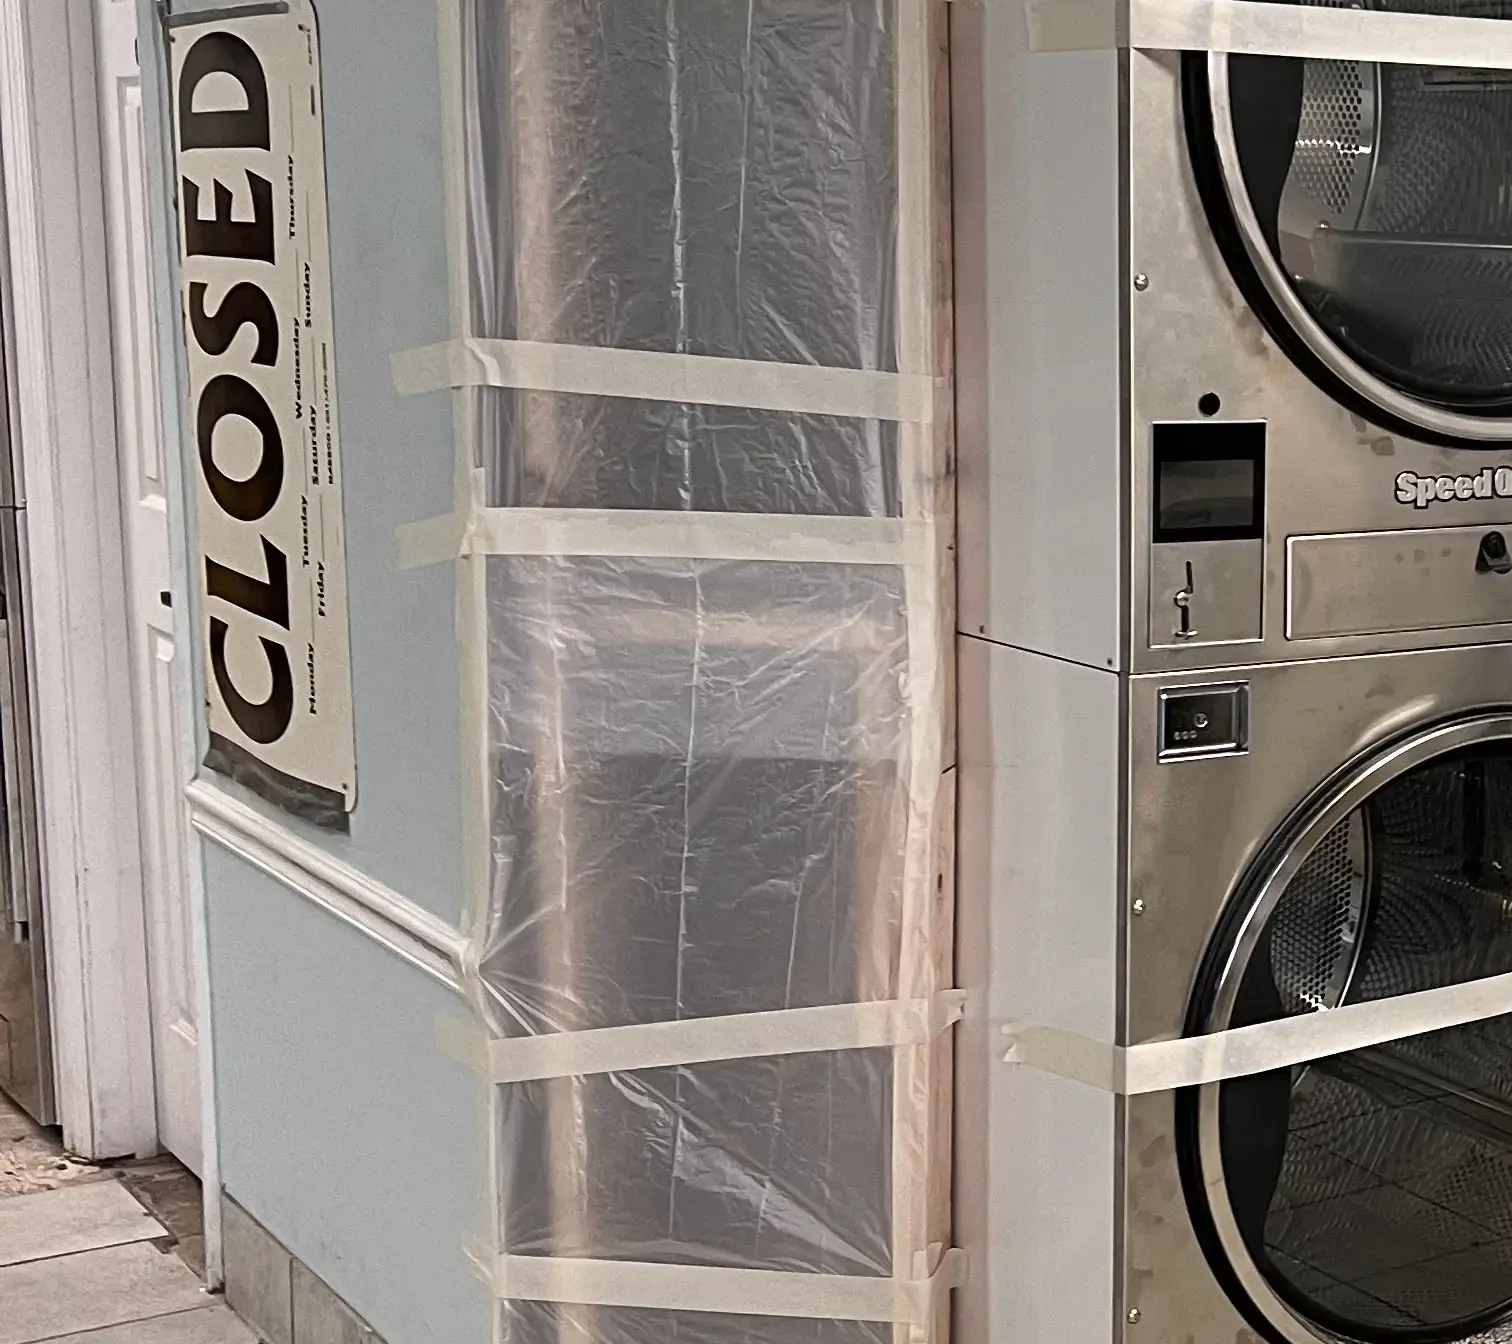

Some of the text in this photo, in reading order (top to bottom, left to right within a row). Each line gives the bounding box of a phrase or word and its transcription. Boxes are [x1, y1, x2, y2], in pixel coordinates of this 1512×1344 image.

[179, 30, 293, 745] CLOSED
[287, 154, 317, 714] Monday Tuesday Wednesday Thursday
[303, 261, 326, 617] Friday Saturday Sunday
[1395, 467, 1494, 508] Speed
